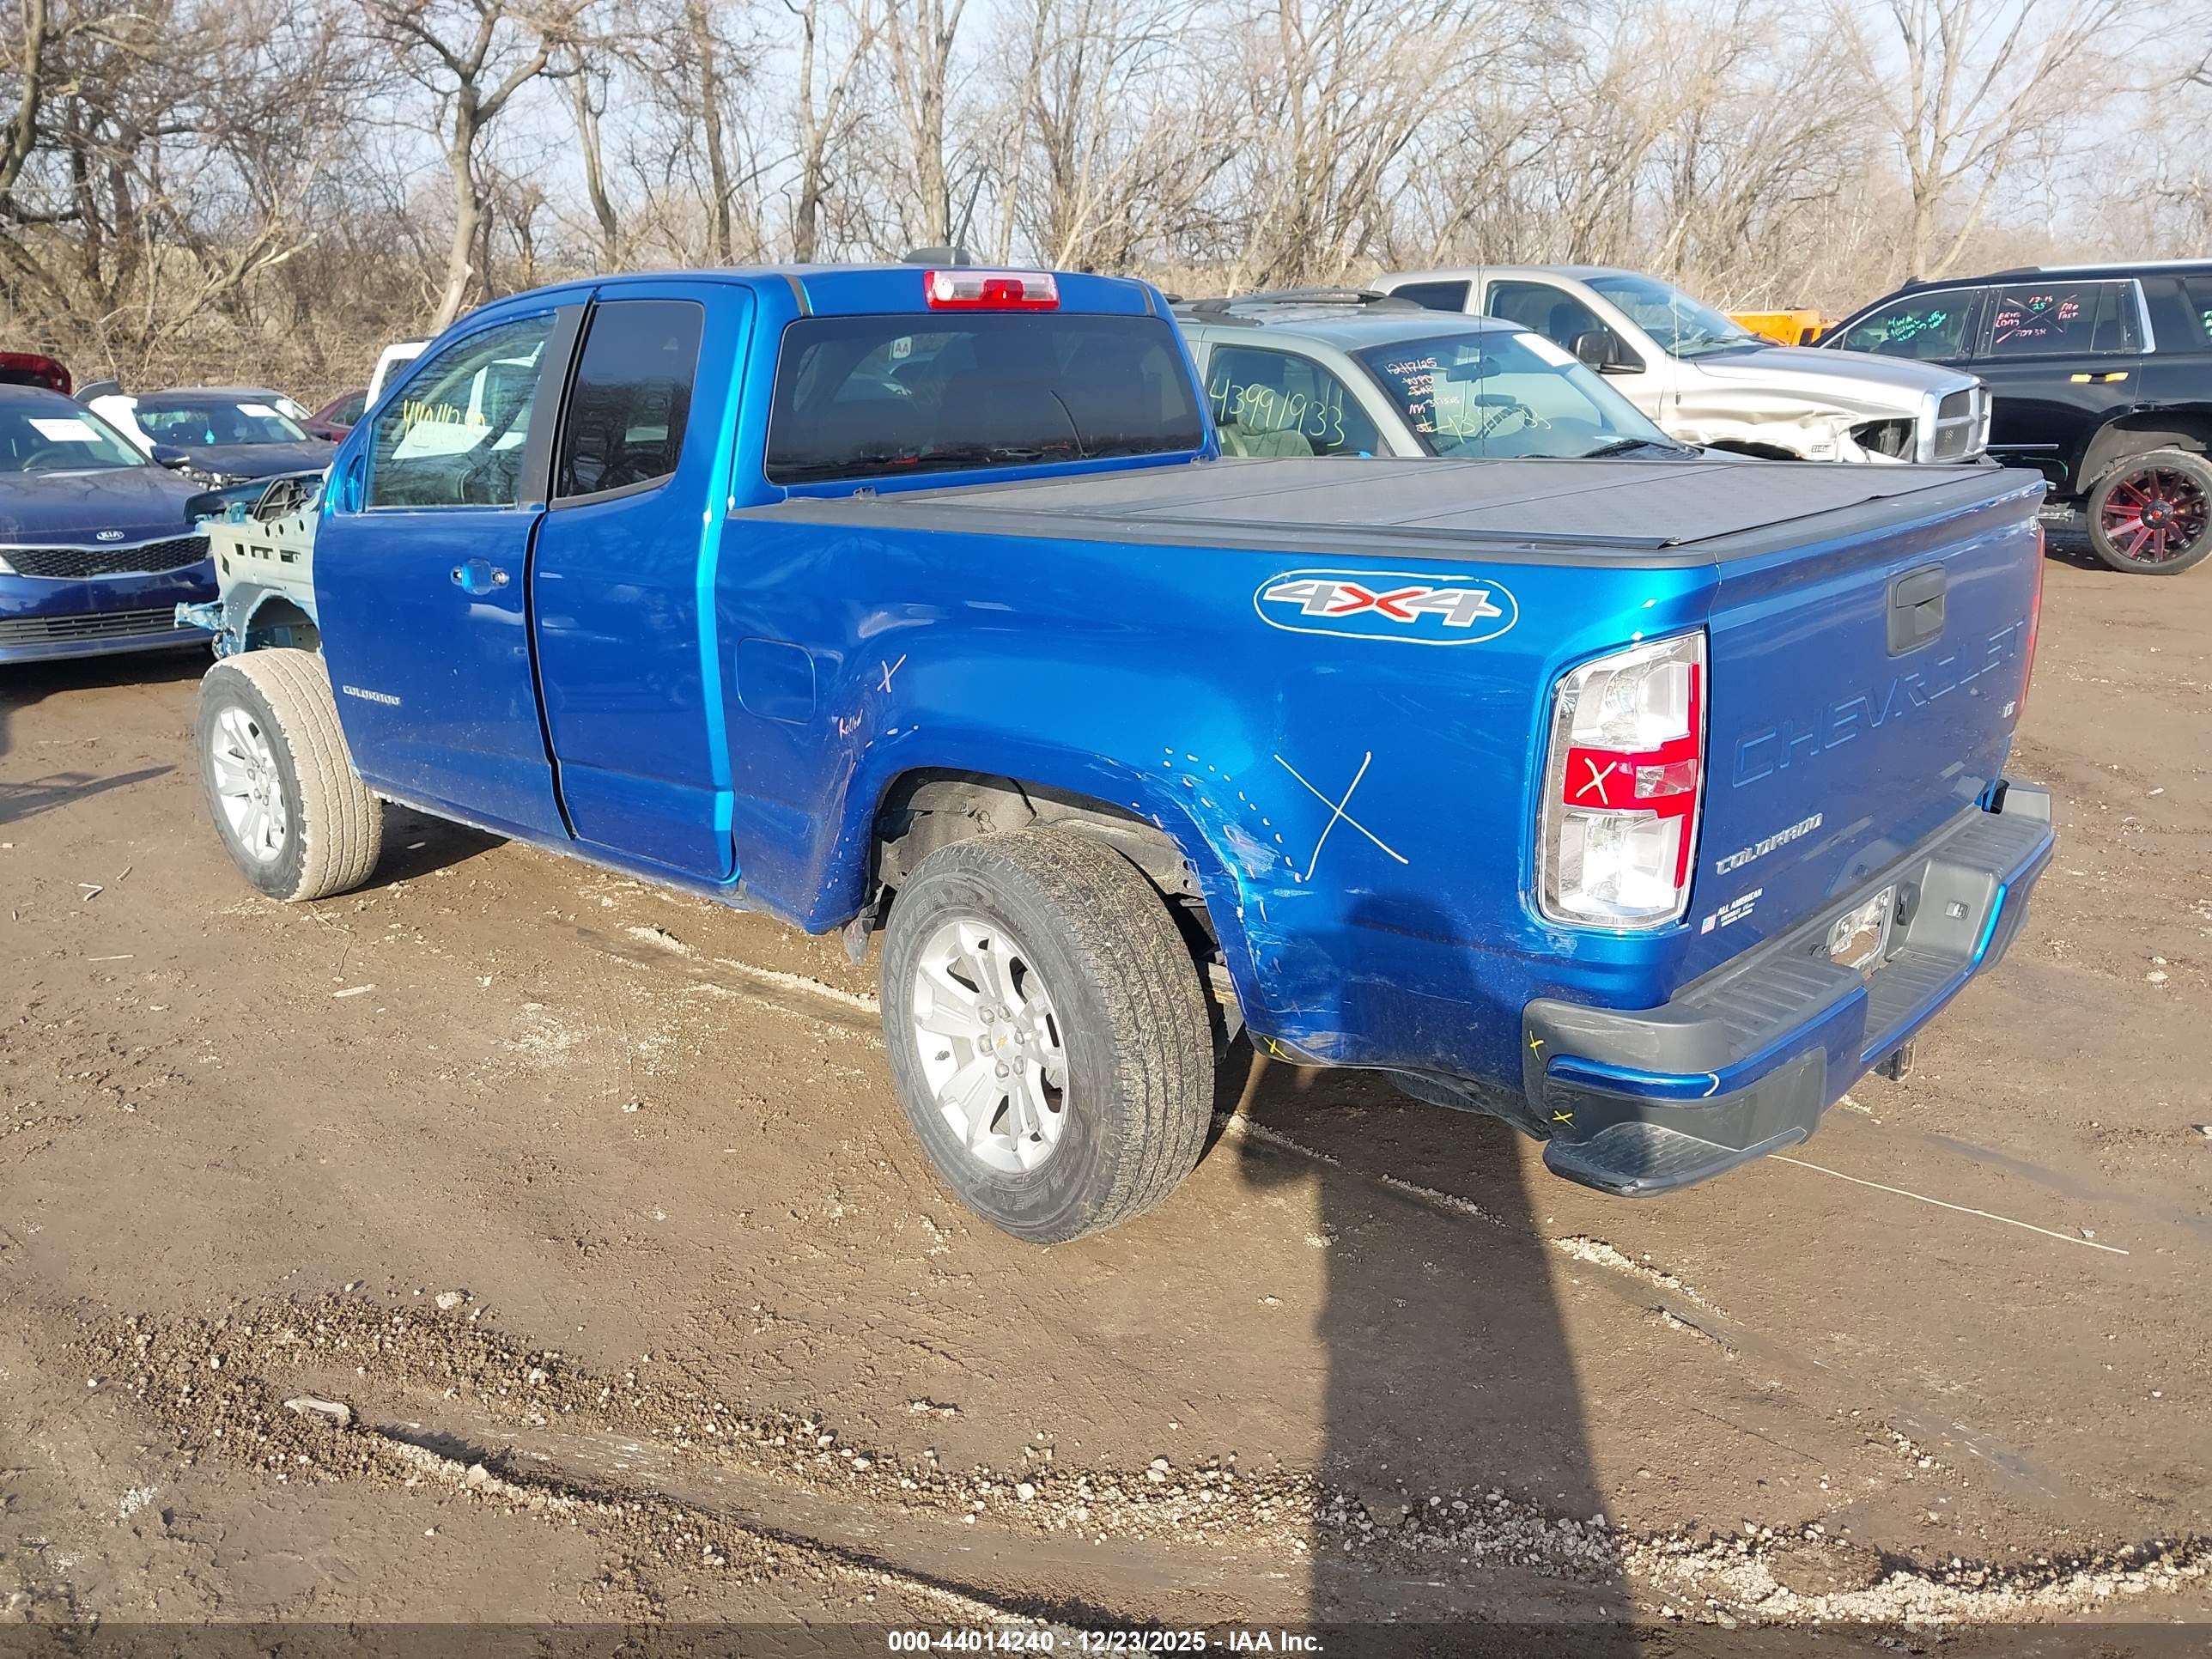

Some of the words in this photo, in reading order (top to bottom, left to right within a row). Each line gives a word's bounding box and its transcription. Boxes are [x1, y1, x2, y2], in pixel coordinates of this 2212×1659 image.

[97, 531, 124, 540] KIA
[342, 684, 401, 706] COLORADO
[1716, 812, 1823, 875] COLORADO
[1717, 903, 1729, 916] ALL
[1730, 887, 1763, 910] AMERICAN
